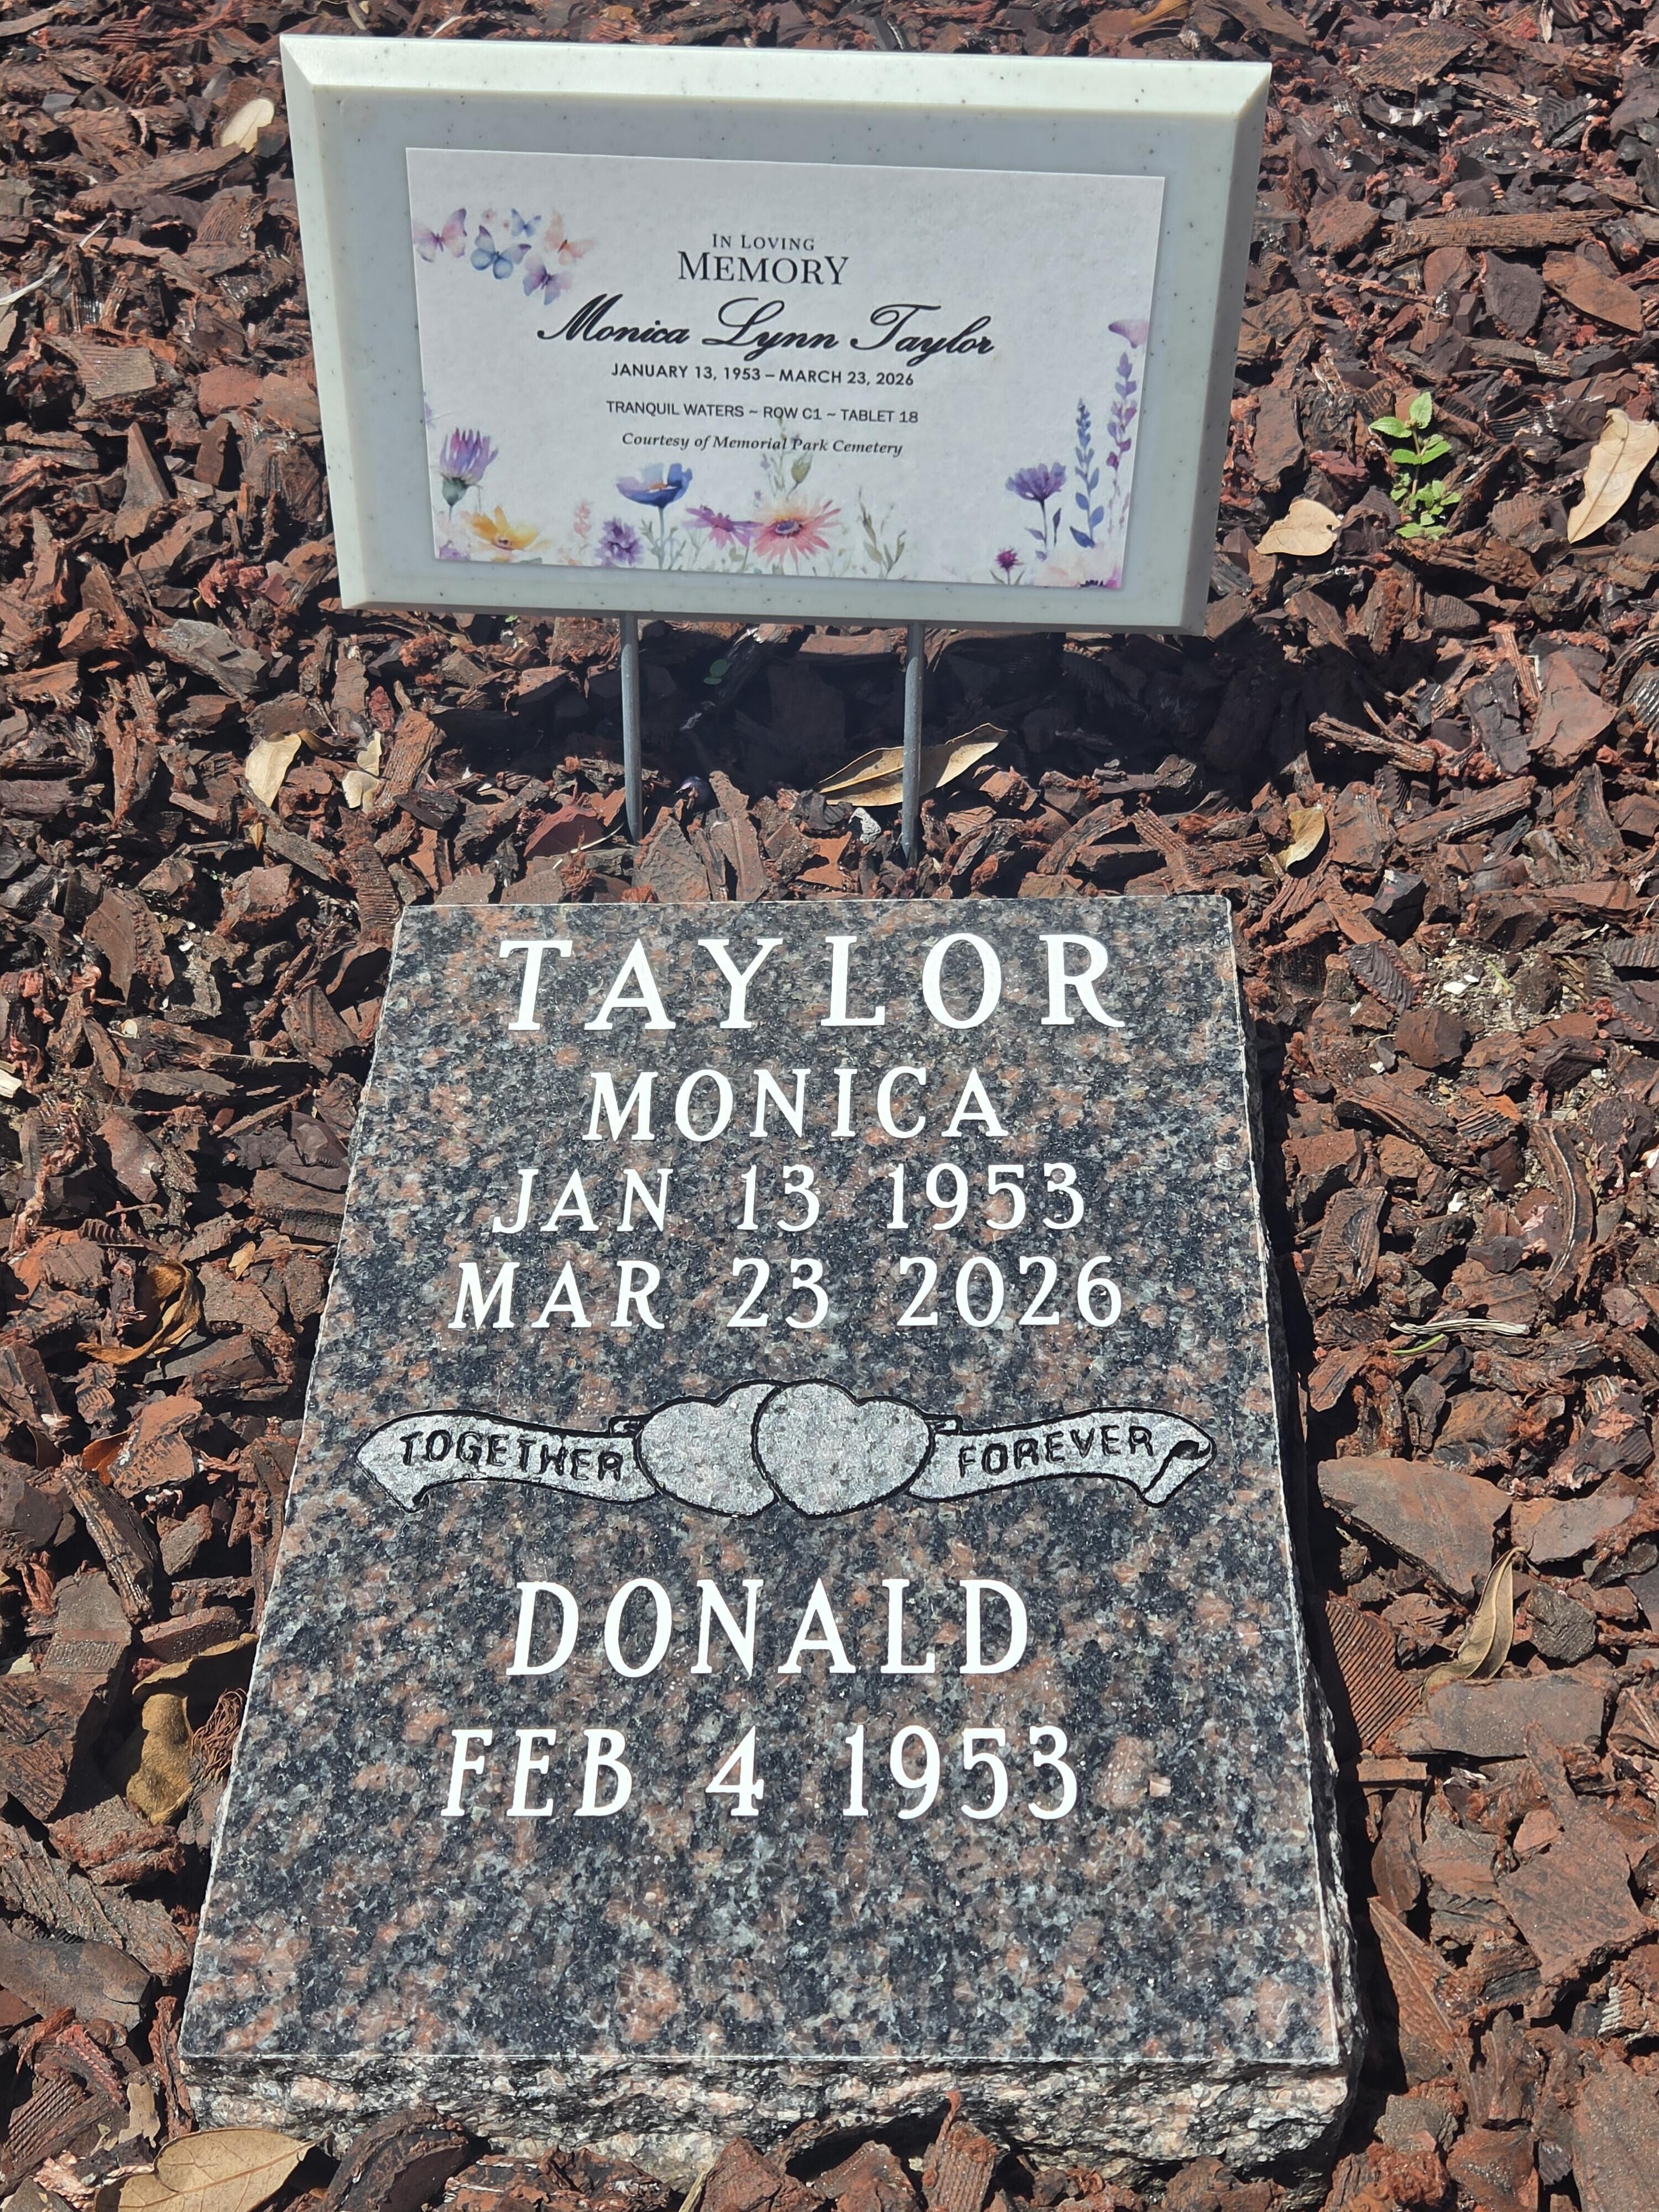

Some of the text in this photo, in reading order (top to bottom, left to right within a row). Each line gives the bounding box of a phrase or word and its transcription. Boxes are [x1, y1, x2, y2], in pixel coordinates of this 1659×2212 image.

[678, 251, 849, 285] MEMORY
[713, 233, 814, 251] IN LOVING
[537, 293, 995, 367] Monica Lynn Taylor
[611, 363, 688, 378] JANUARY
[695, 366, 717, 381] 13,
[724, 367, 761, 381] 1953
[779, 369, 842, 384] MARCH
[847, 371, 870, 386] 23,
[875, 372, 914, 386] 2026
[606, 400, 680, 417] TRANQUIL
[683, 403, 744, 418] WATERS
[763, 406, 799, 420] ROW
[802, 408, 822, 420] C1
[840, 409, 895, 422] TABLET
[899, 411, 919, 424] 18
[622, 432, 903, 458] Courtesy of Memorial Park Cemetery
[498, 932, 1126, 1031] TAYLOR
[581, 1065, 1010, 1143] MONICA
[491, 1161, 1085, 1235] JAN 13 1953
[447, 1254, 1123, 1331] MAR 23 2026
[399, 1424, 1153, 1482] TOGETHER FOREVER
[505, 1577, 1029, 1678] DONALD
[440, 1723, 1078, 1820] FEB 4 1953
